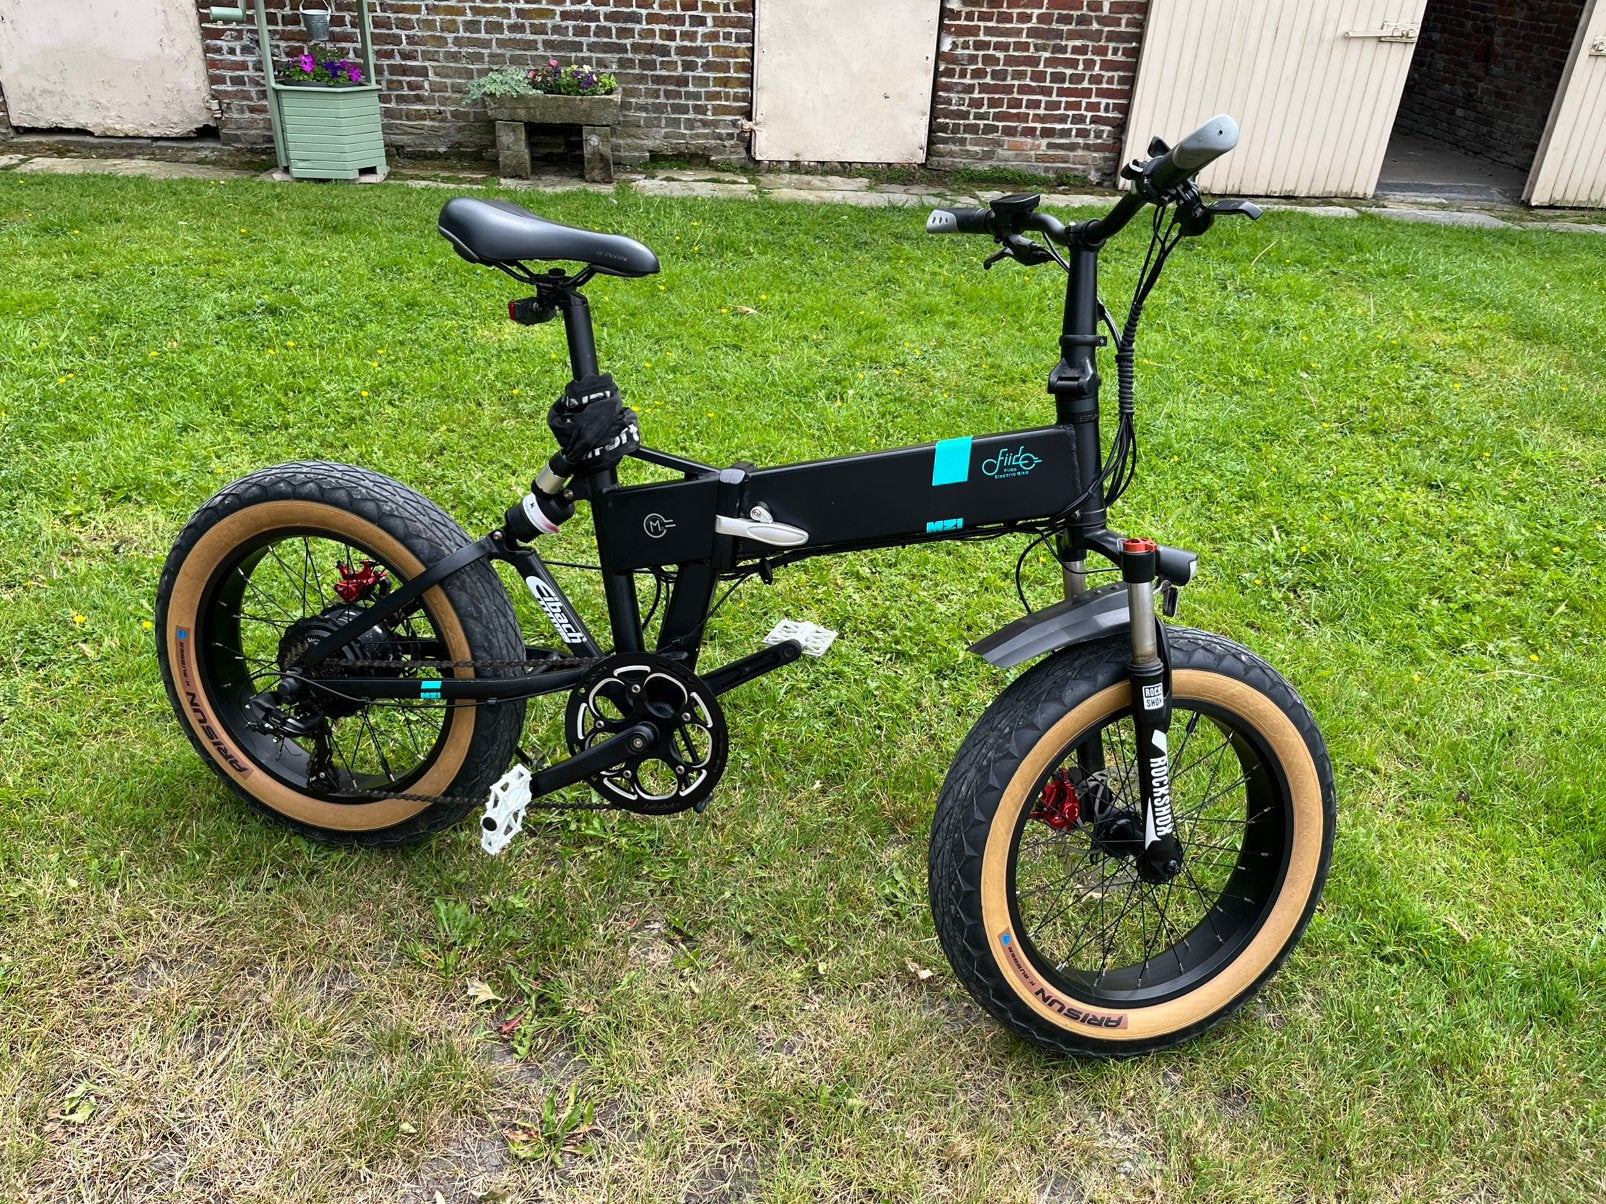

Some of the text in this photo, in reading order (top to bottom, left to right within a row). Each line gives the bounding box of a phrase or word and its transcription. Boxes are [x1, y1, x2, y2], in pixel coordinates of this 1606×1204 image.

[186, 690, 250, 773] ARISUN
[1150, 755, 1174, 837] ROCKSHOX
[1035, 987, 1124, 1028] ARISUN
